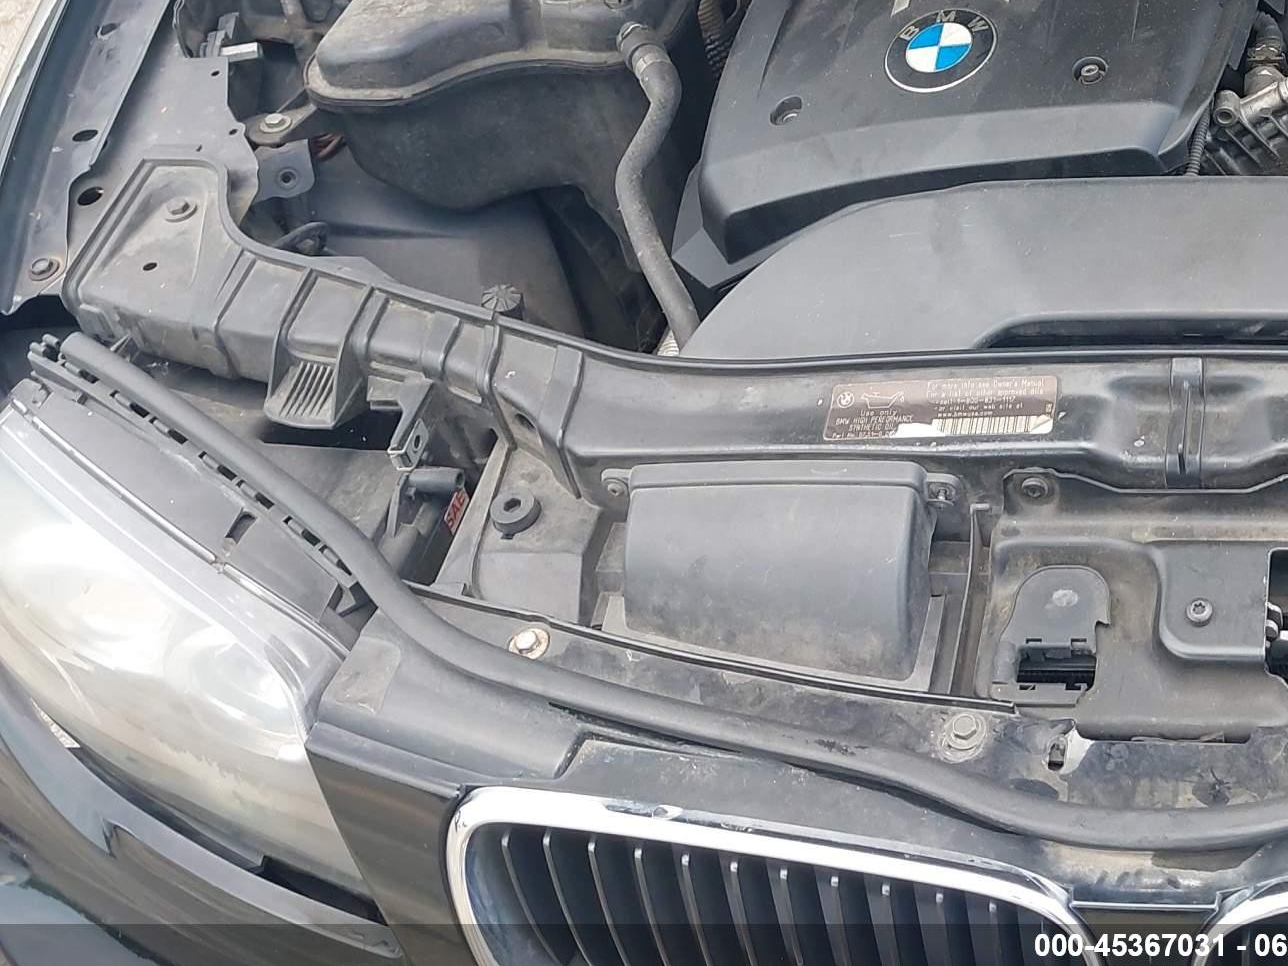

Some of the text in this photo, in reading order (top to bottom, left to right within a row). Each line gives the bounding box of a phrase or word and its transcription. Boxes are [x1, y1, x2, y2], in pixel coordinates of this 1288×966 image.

[899, 10, 989, 41] BMW
[961, 379, 975, 389] info
[1021, 377, 1044, 387] Manual
[860, 409, 875, 417] Use
[836, 414, 913, 425] BMW HIGH PERFORMANCE
